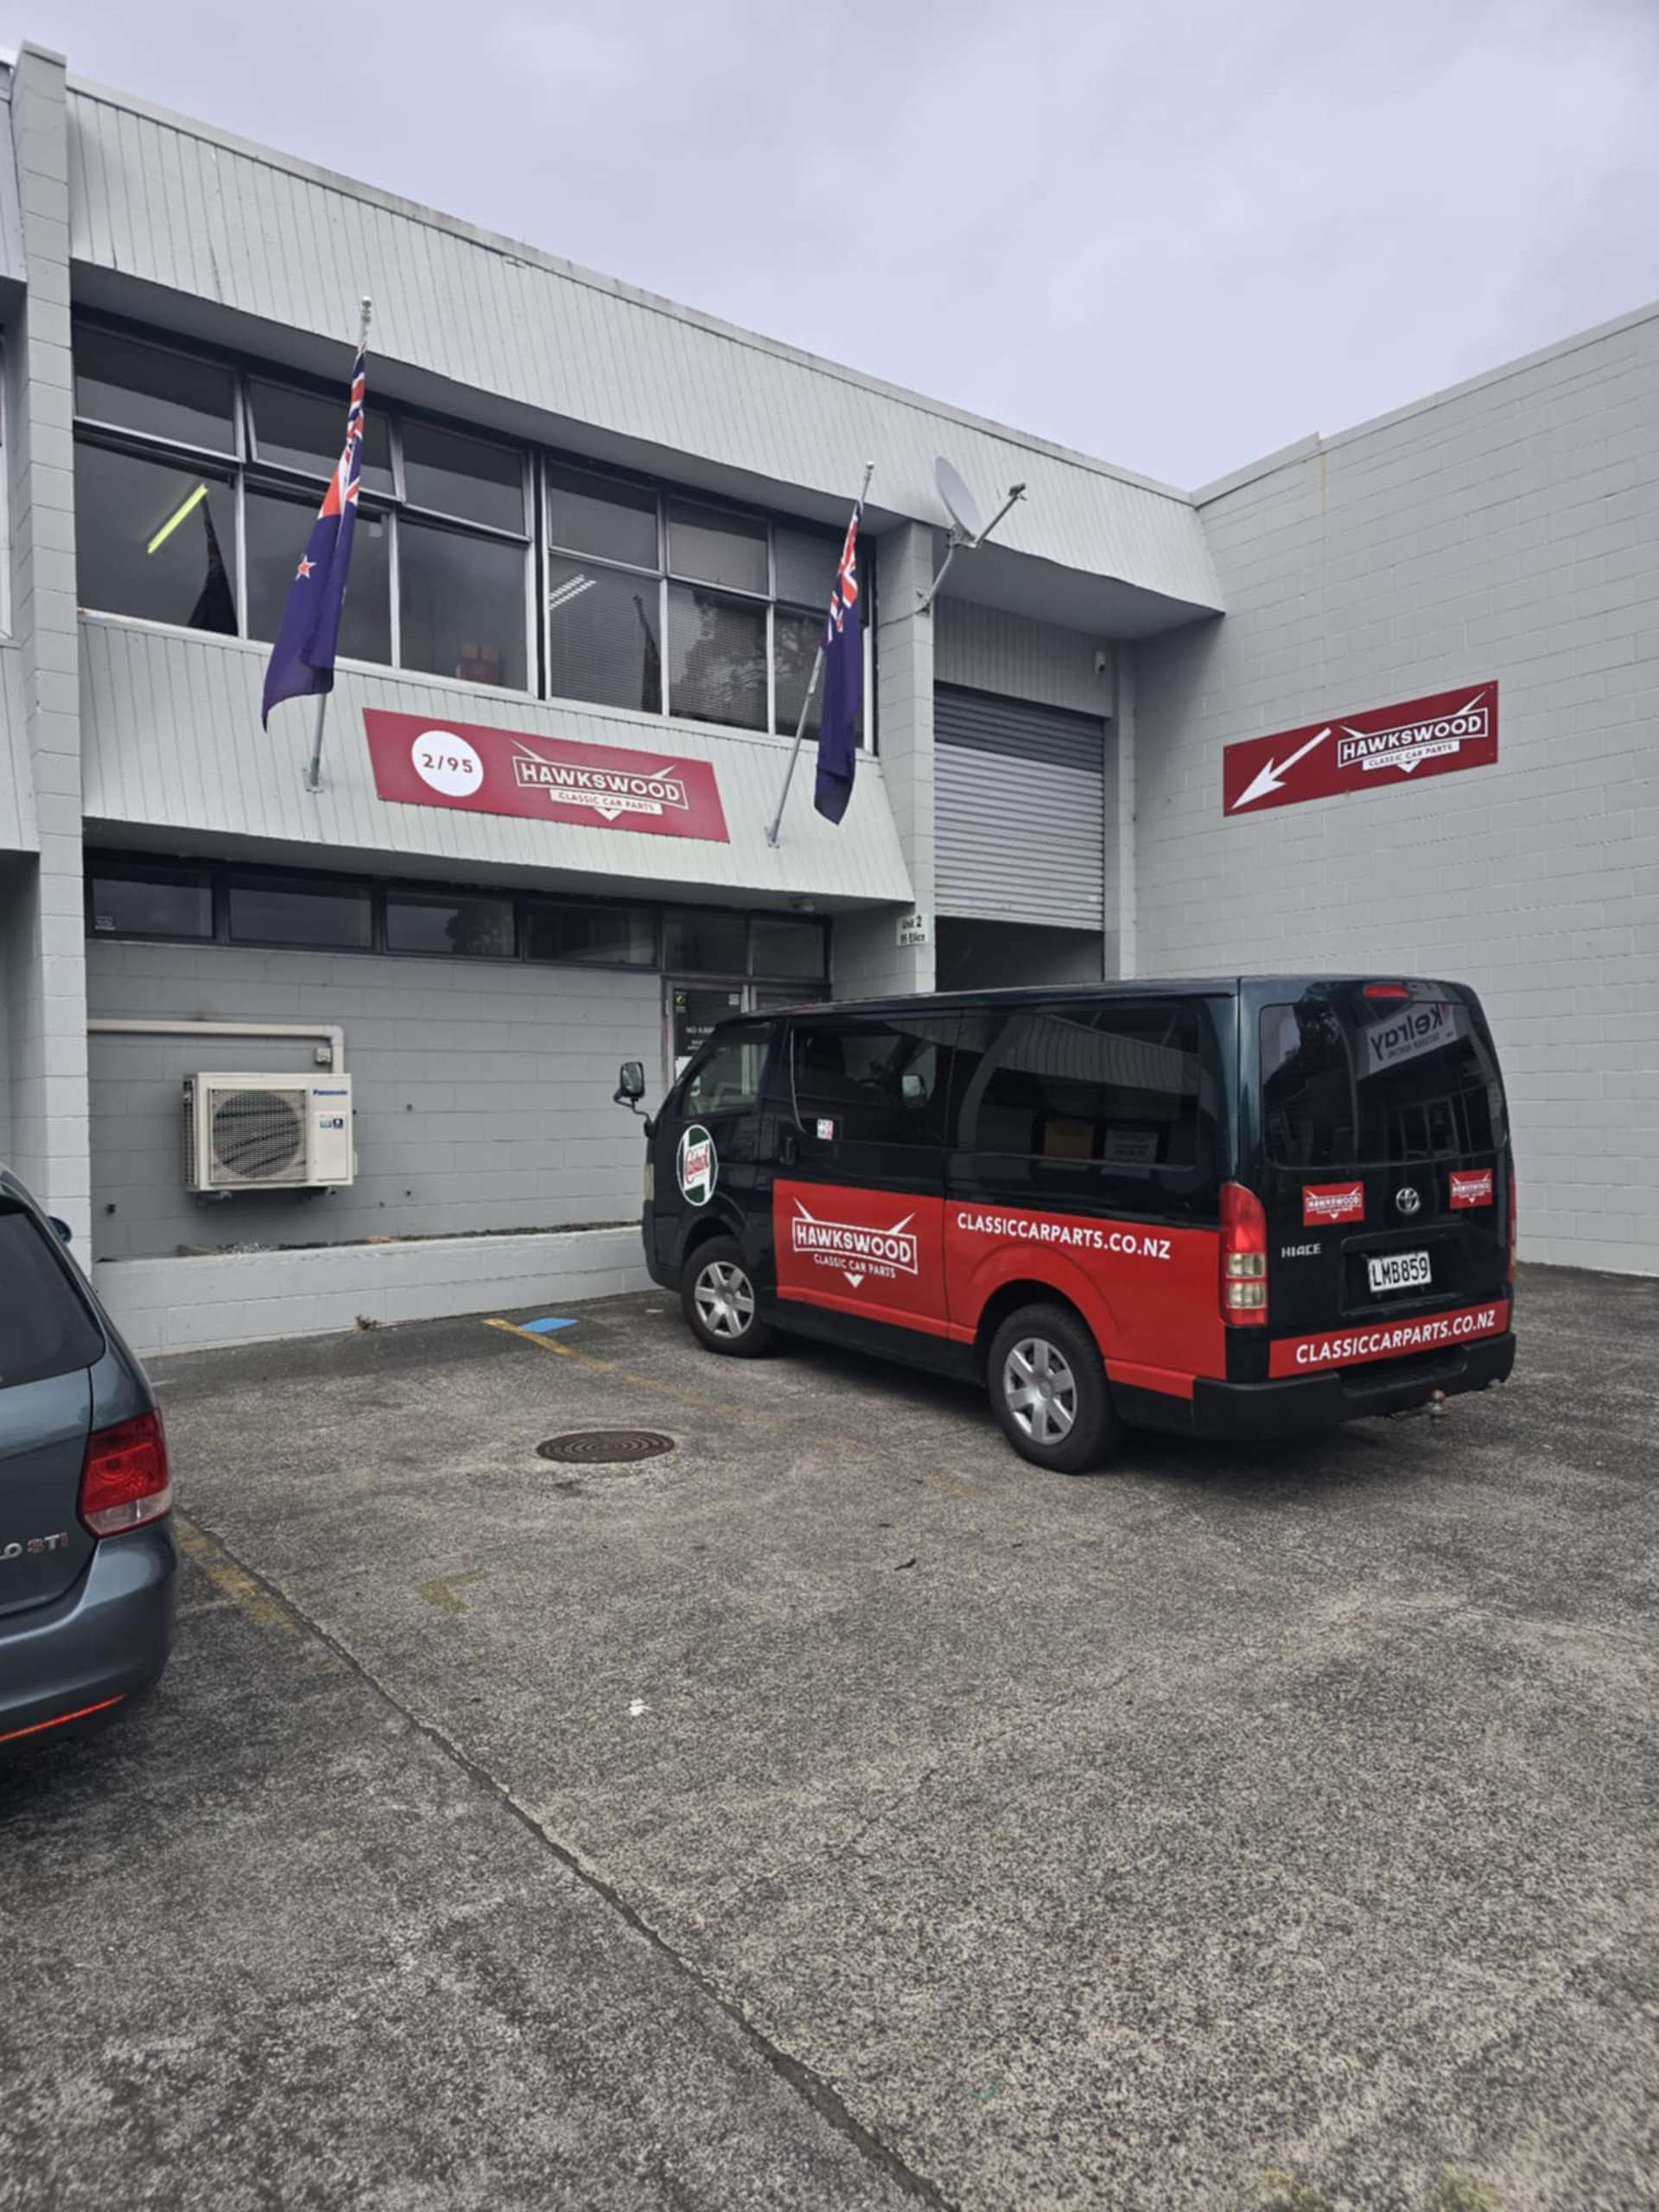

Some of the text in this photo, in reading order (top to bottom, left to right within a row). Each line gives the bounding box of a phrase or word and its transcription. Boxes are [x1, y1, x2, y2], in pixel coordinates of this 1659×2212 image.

[1343, 715, 1481, 760] HAWKSWOOD
[422, 753, 473, 773] 2/95
[1369, 744, 1452, 767] CLASSIC CAR PARTS
[520, 762, 680, 801] HAWKSWOOD
[559, 791, 655, 811] CLASSIC CAR PARTS
[916, 915, 922, 928] 2
[797, 1224, 912, 1263] HAWKSWOOD
[957, 1212, 1171, 1260] CLASSICCARPARTS.CO.NZ
[1281, 1243, 1322, 1259] HIACE
[813, 1253, 896, 1279] CLASSIC CAR PARTS
[1372, 1256, 1428, 1287] LMB859
[1296, 1309, 1496, 1364] CLASSICCARPARTS.CO.NZ
